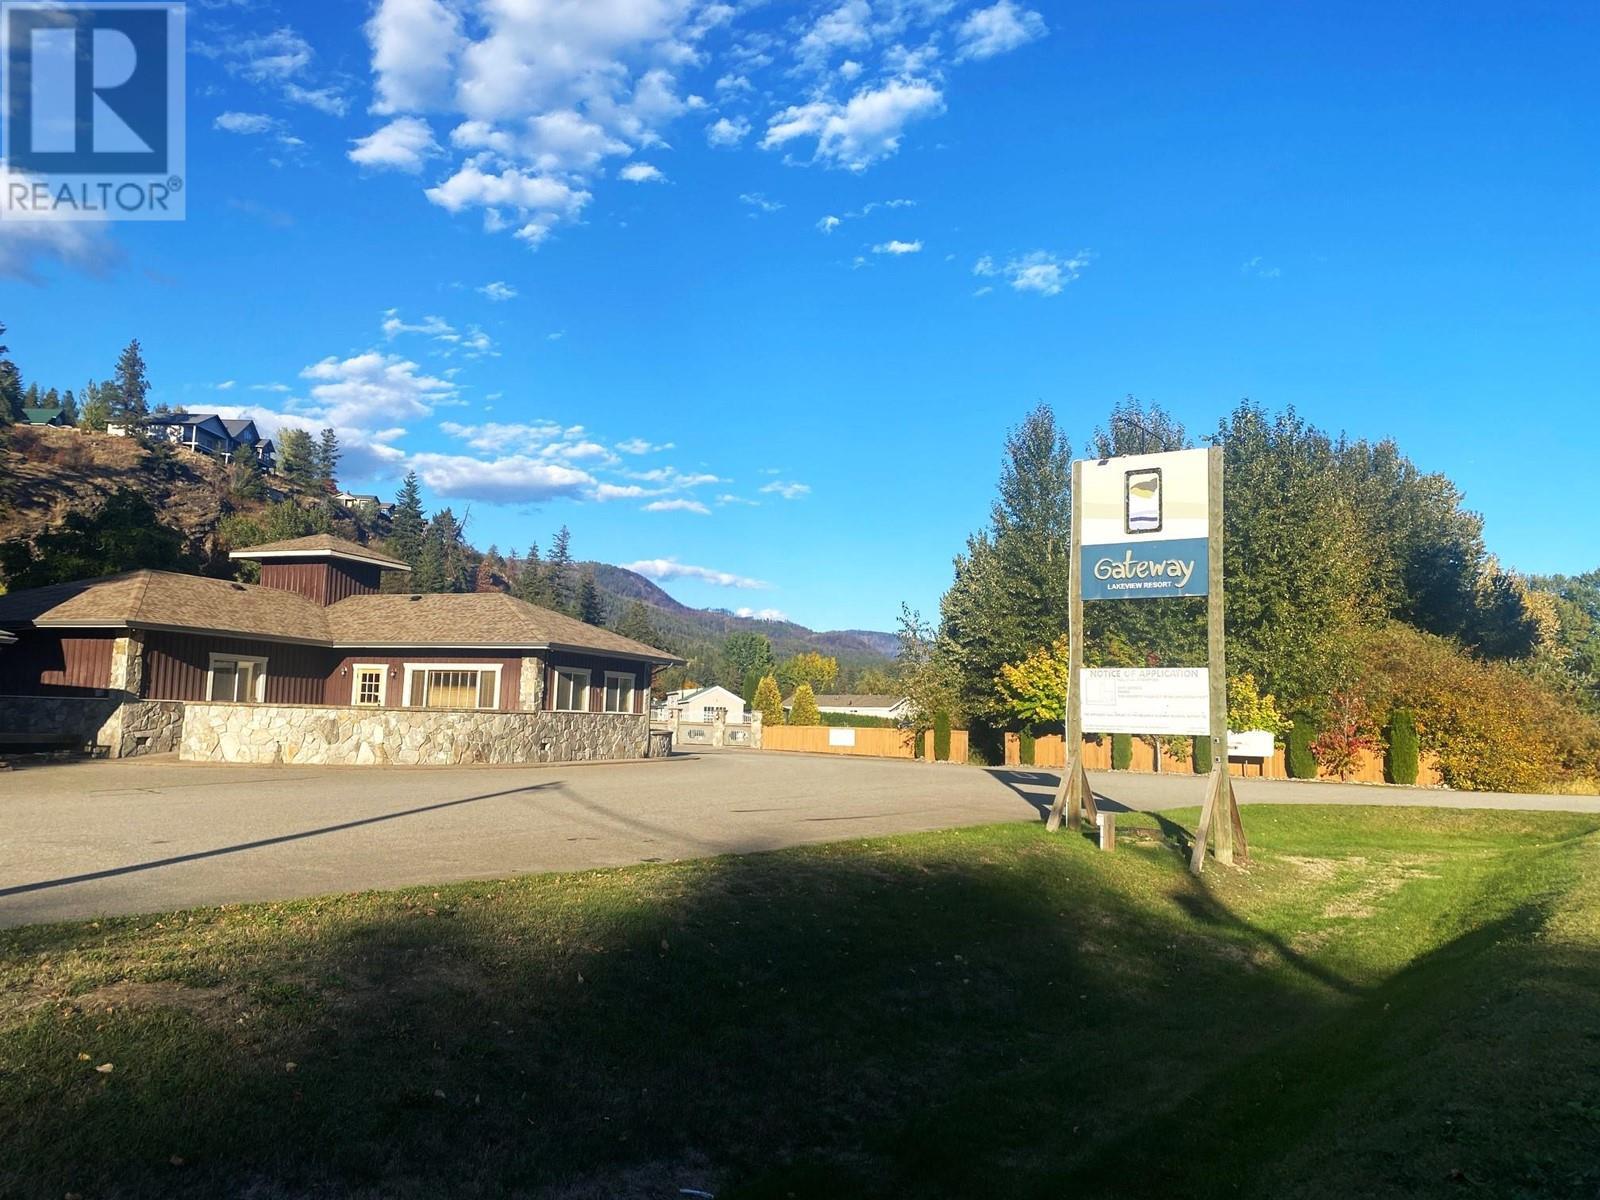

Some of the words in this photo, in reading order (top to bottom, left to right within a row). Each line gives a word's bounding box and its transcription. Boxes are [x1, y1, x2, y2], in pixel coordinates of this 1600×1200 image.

[1094, 549, 1195, 588] Gateway
[1107, 582, 1142, 590] LAKEVIEW
[1143, 581, 1172, 589] RESORT
[1089, 669, 1121, 678] NOTICE
[1124, 669, 1137, 678] OF
[1139, 669, 1199, 678] APPLICATION
